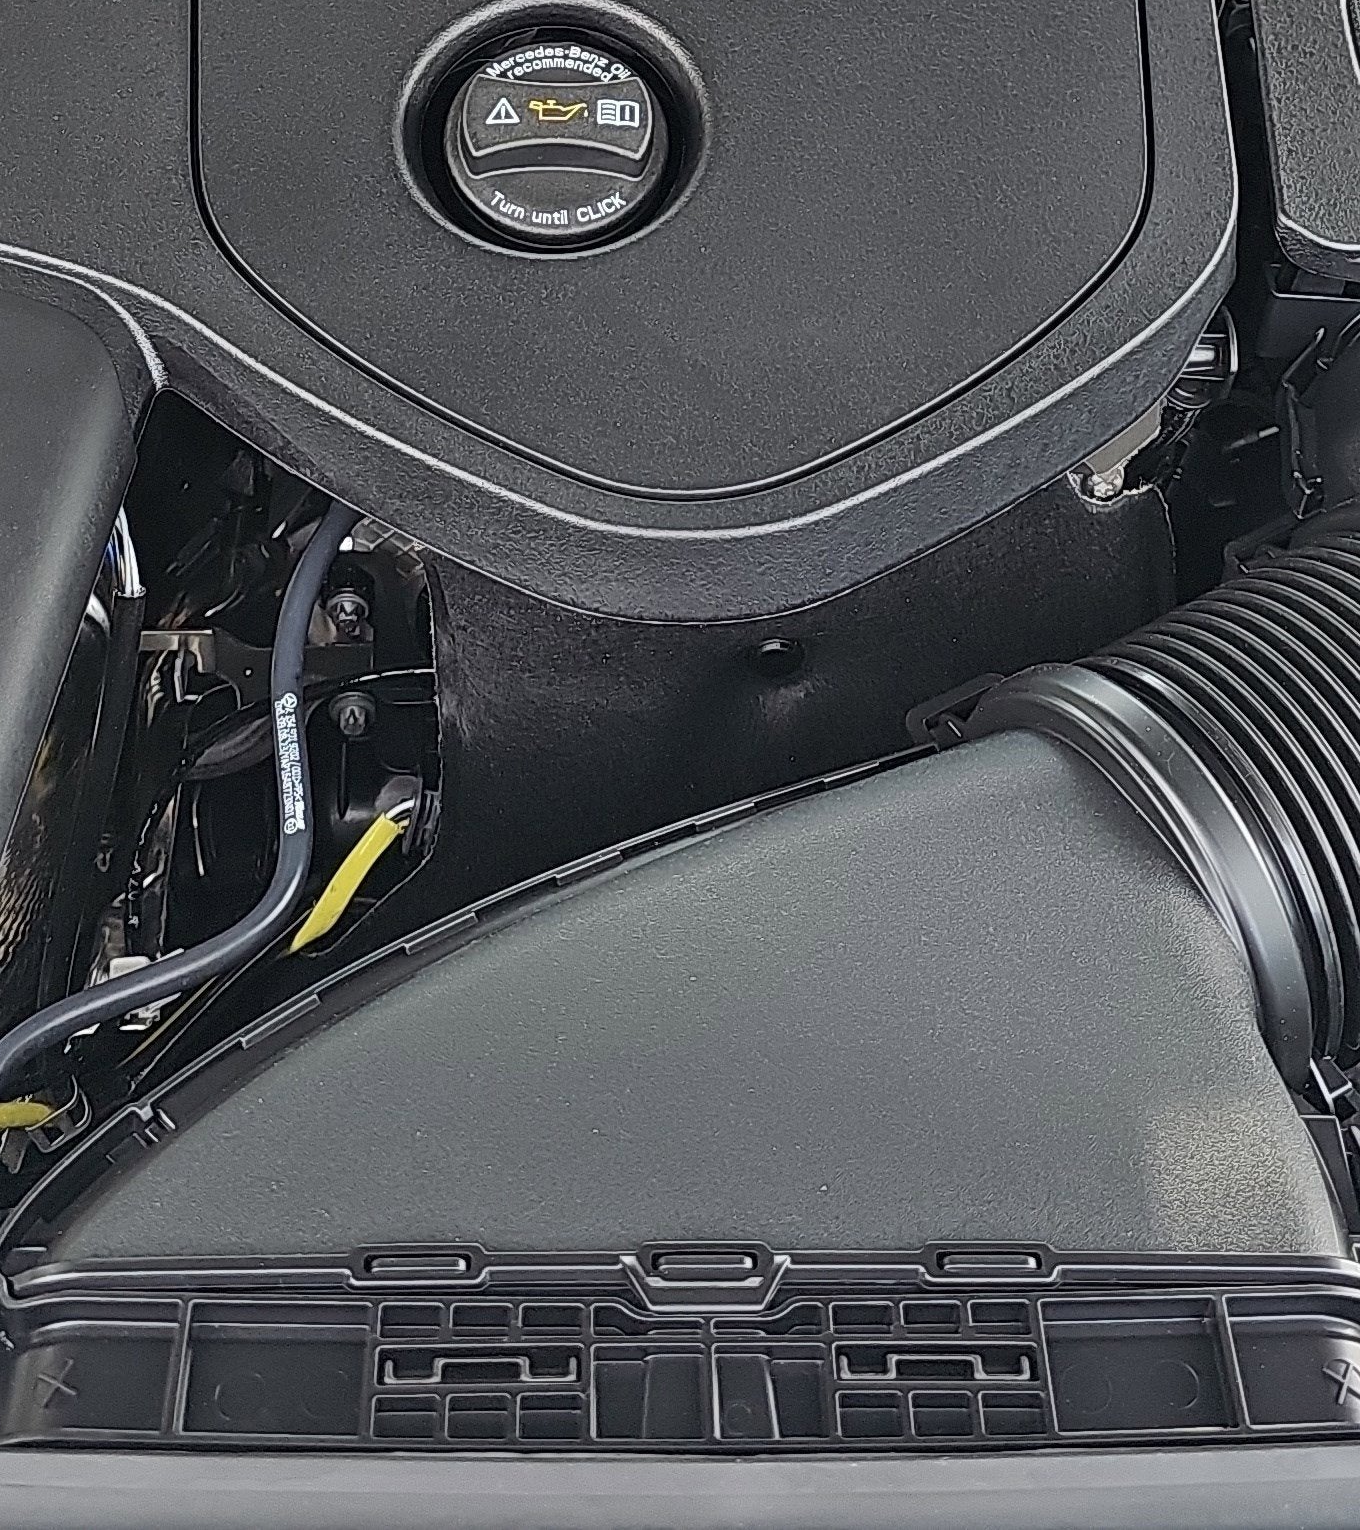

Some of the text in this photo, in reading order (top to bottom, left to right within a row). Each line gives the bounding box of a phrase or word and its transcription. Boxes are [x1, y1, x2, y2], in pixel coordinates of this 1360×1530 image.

[485, 45, 631, 79] Mercedes-Benz Oil
[506, 56, 613, 83] recommended
[490, 190, 627, 225] Turn until CLICK
